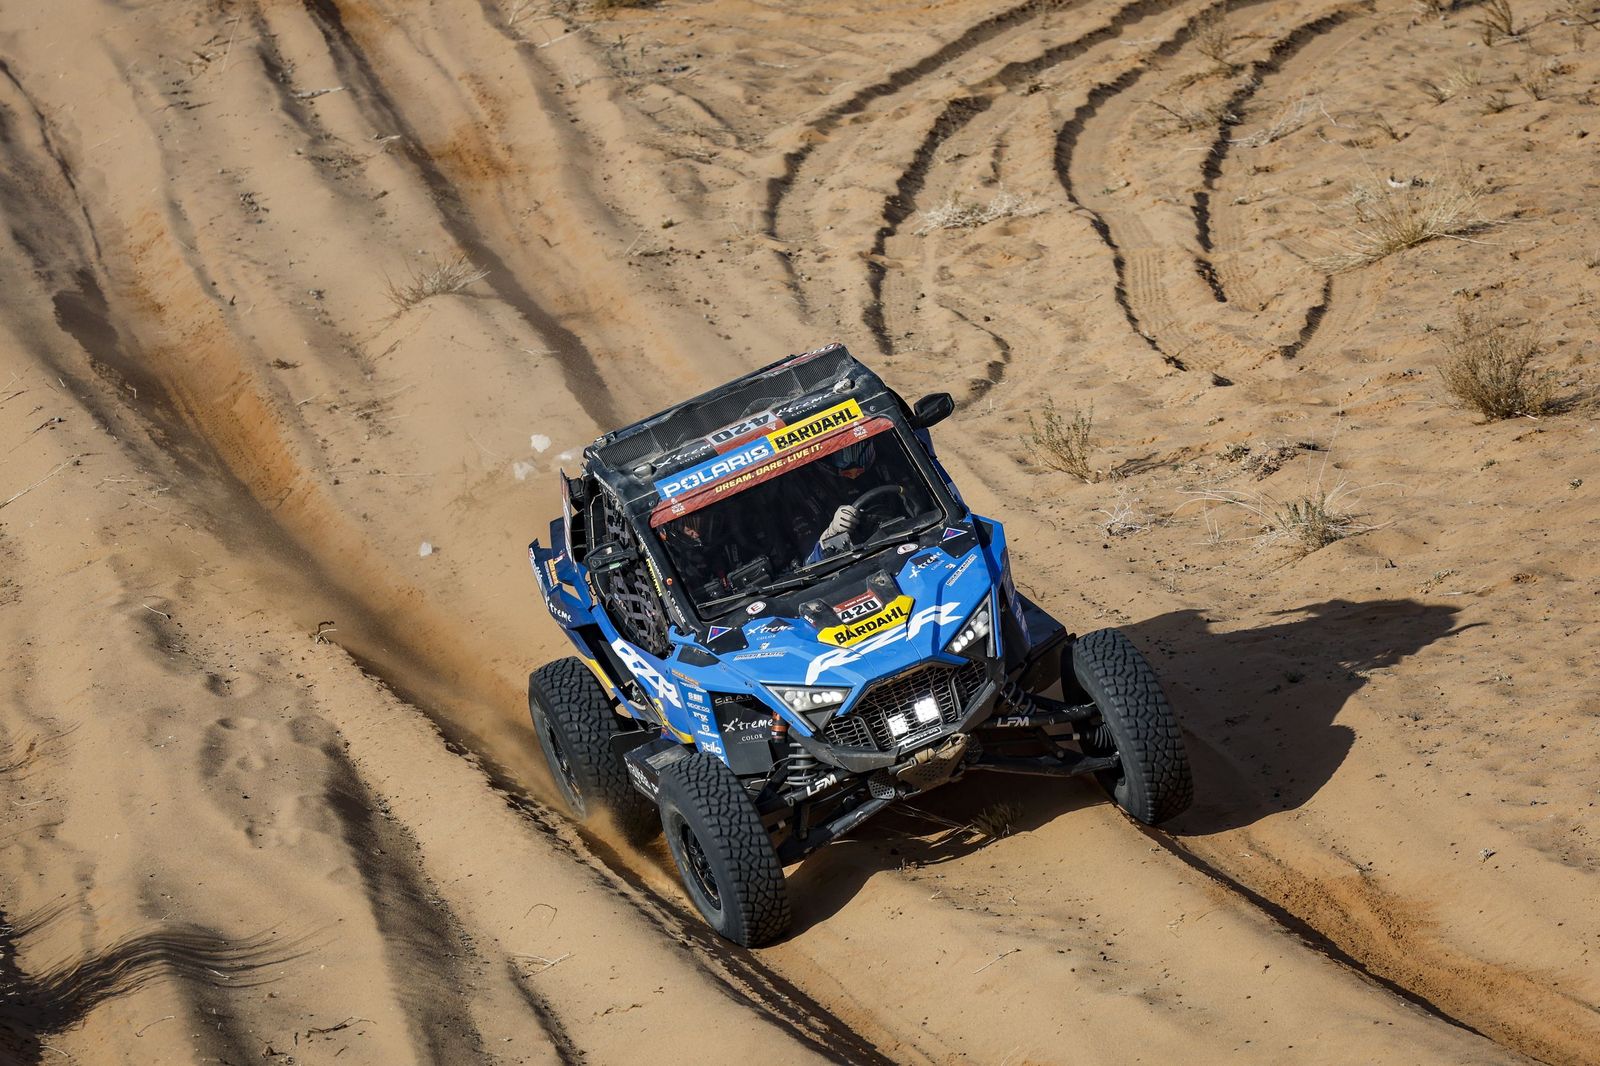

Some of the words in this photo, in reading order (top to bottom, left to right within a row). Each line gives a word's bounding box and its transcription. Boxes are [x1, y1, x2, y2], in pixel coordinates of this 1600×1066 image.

[711, 414, 770, 443] 420
[773, 407, 859, 450] BARDAHL
[663, 445, 770, 498] POLARIS
[715, 472, 755, 493] DREAM.
[756, 460, 786, 476] DARE.
[787, 448, 809, 463] LIVE
[810, 443, 824, 453] IT.
[834, 606, 909, 646] BARDAHL
[840, 599, 879, 622] 420
[805, 602, 964, 686] RZR
[611, 637, 683, 708] RZR
[741, 733, 764, 742] COLOR
[996, 716, 1030, 728] LFM
[806, 773, 838, 797] LFM
